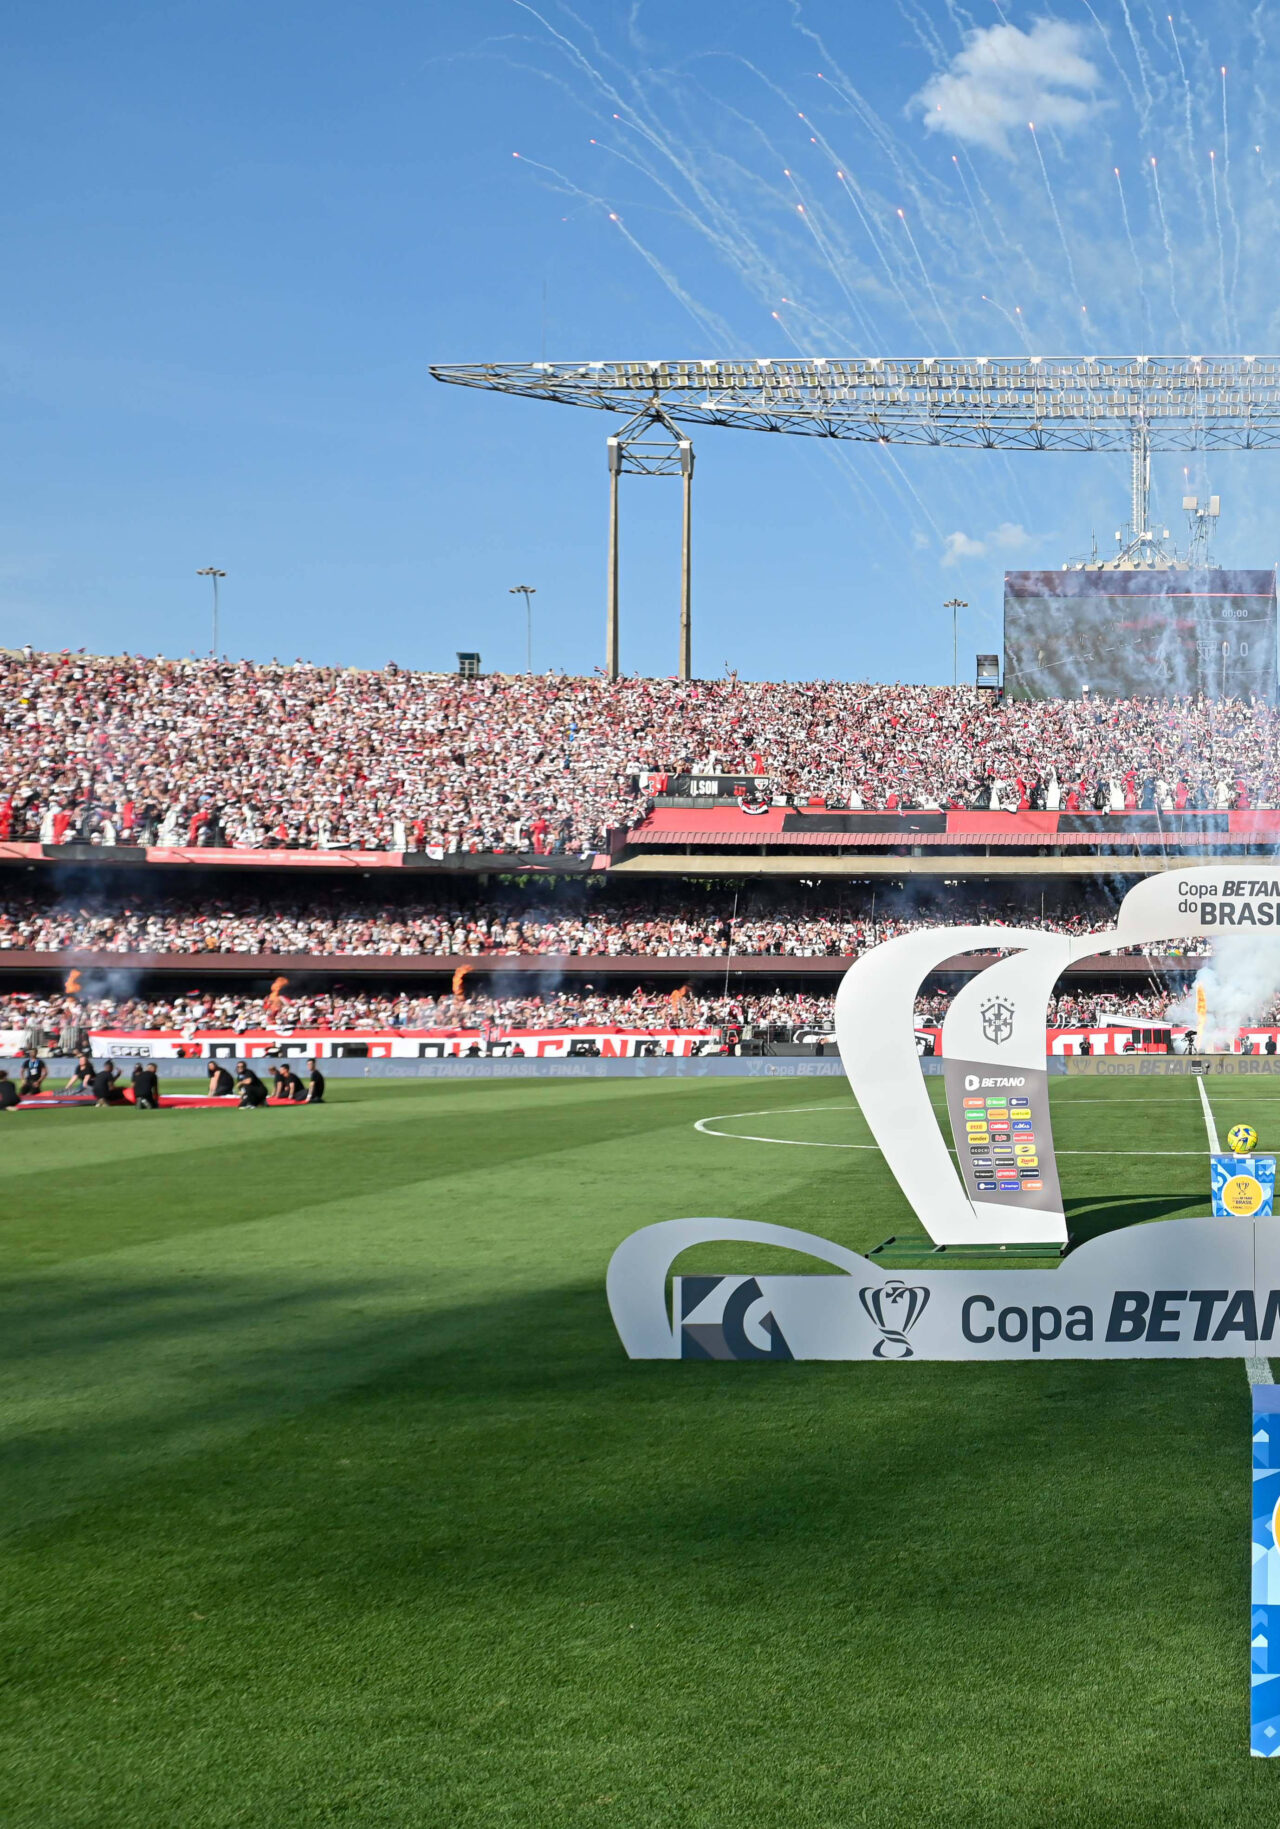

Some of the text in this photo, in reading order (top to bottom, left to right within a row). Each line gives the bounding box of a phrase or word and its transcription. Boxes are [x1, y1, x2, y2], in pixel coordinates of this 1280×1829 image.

[1222, 609, 1248, 617] 00:00
[1239, 642, 1249, 657] 0
[1178, 881, 1218, 899] Copa
[1178, 899, 1198, 913] do
[111, 1046, 151, 1057] SPFC
[385, 1062, 590, 1078] Copa BETANO do BRASIL FINAL
[764, 1061, 844, 1077] Copa BETAN
[1096, 1060, 1136, 1076] Copa
[1215, 1060, 1235, 1074] do
[981, 1076, 1026, 1088] BETANO
[961, 1293, 1094, 1352] Copa
